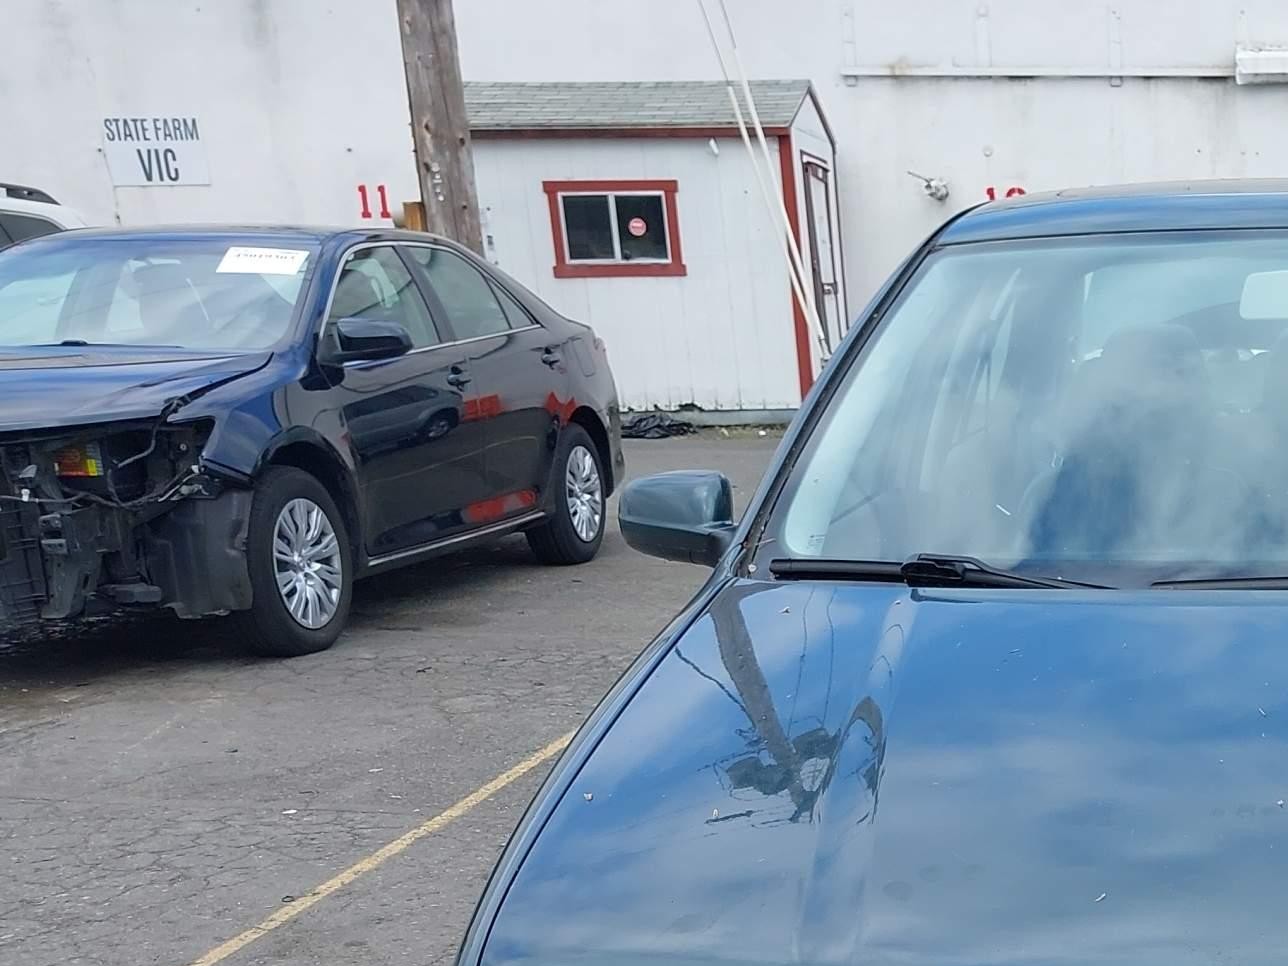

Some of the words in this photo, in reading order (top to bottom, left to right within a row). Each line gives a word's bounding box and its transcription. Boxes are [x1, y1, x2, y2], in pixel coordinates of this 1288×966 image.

[104, 118, 151, 141] STATE
[153, 118, 199, 141] FARM
[136, 148, 179, 182] VIC
[358, 185, 391, 218] 11
